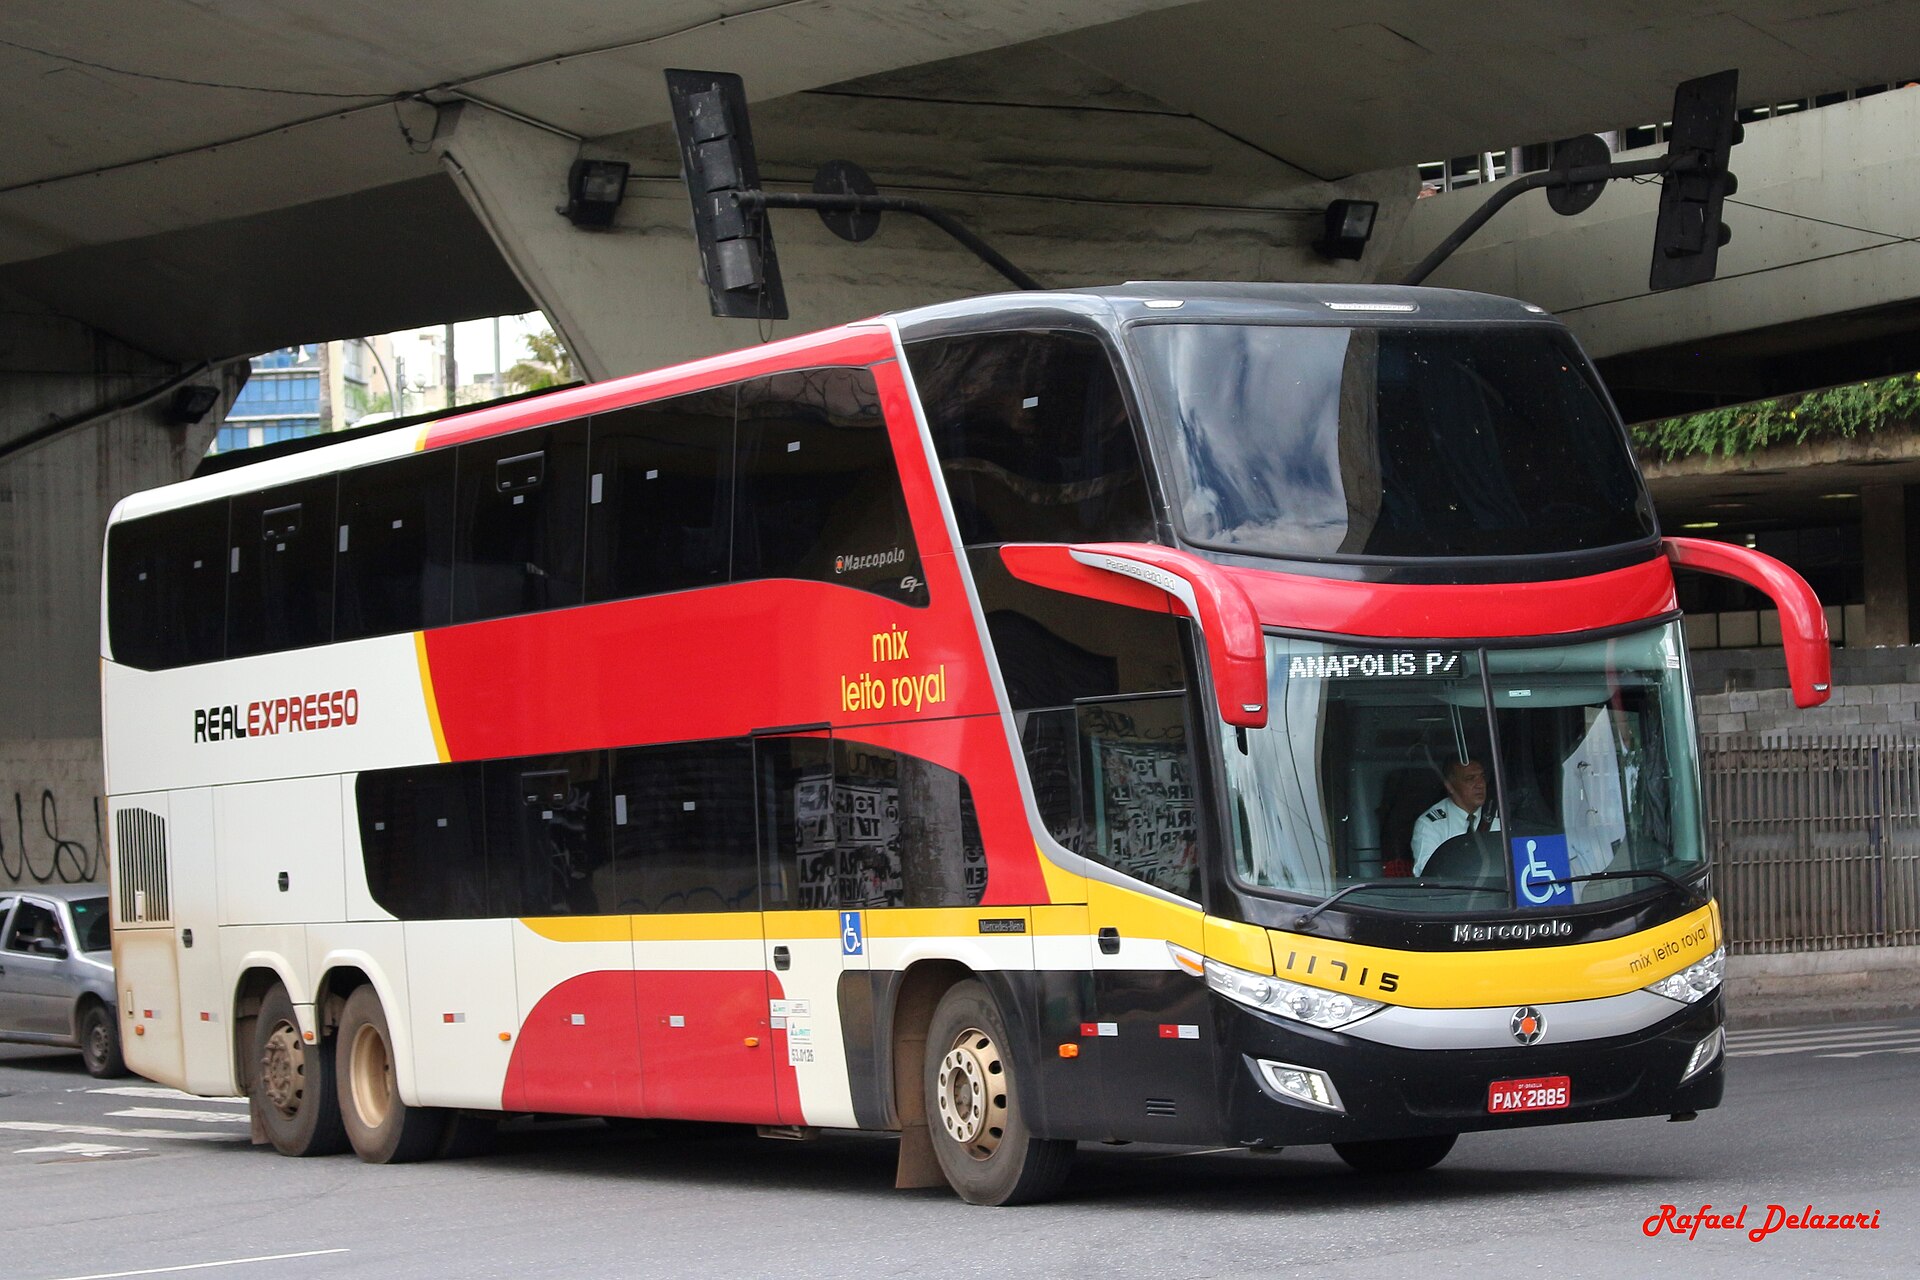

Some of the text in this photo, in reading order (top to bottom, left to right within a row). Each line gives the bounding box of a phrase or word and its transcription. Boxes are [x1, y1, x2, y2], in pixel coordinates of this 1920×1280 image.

[843, 547, 905, 571] Marcopolo
[872, 623, 910, 662] mix
[1289, 653, 1416, 679] ANAPOLIS
[841, 664, 946, 713] leito royal
[1454, 920, 1573, 942] Marcopolo
[1629, 923, 1709, 973] mix leito royal
[1286, 951, 1400, 993] 11715
